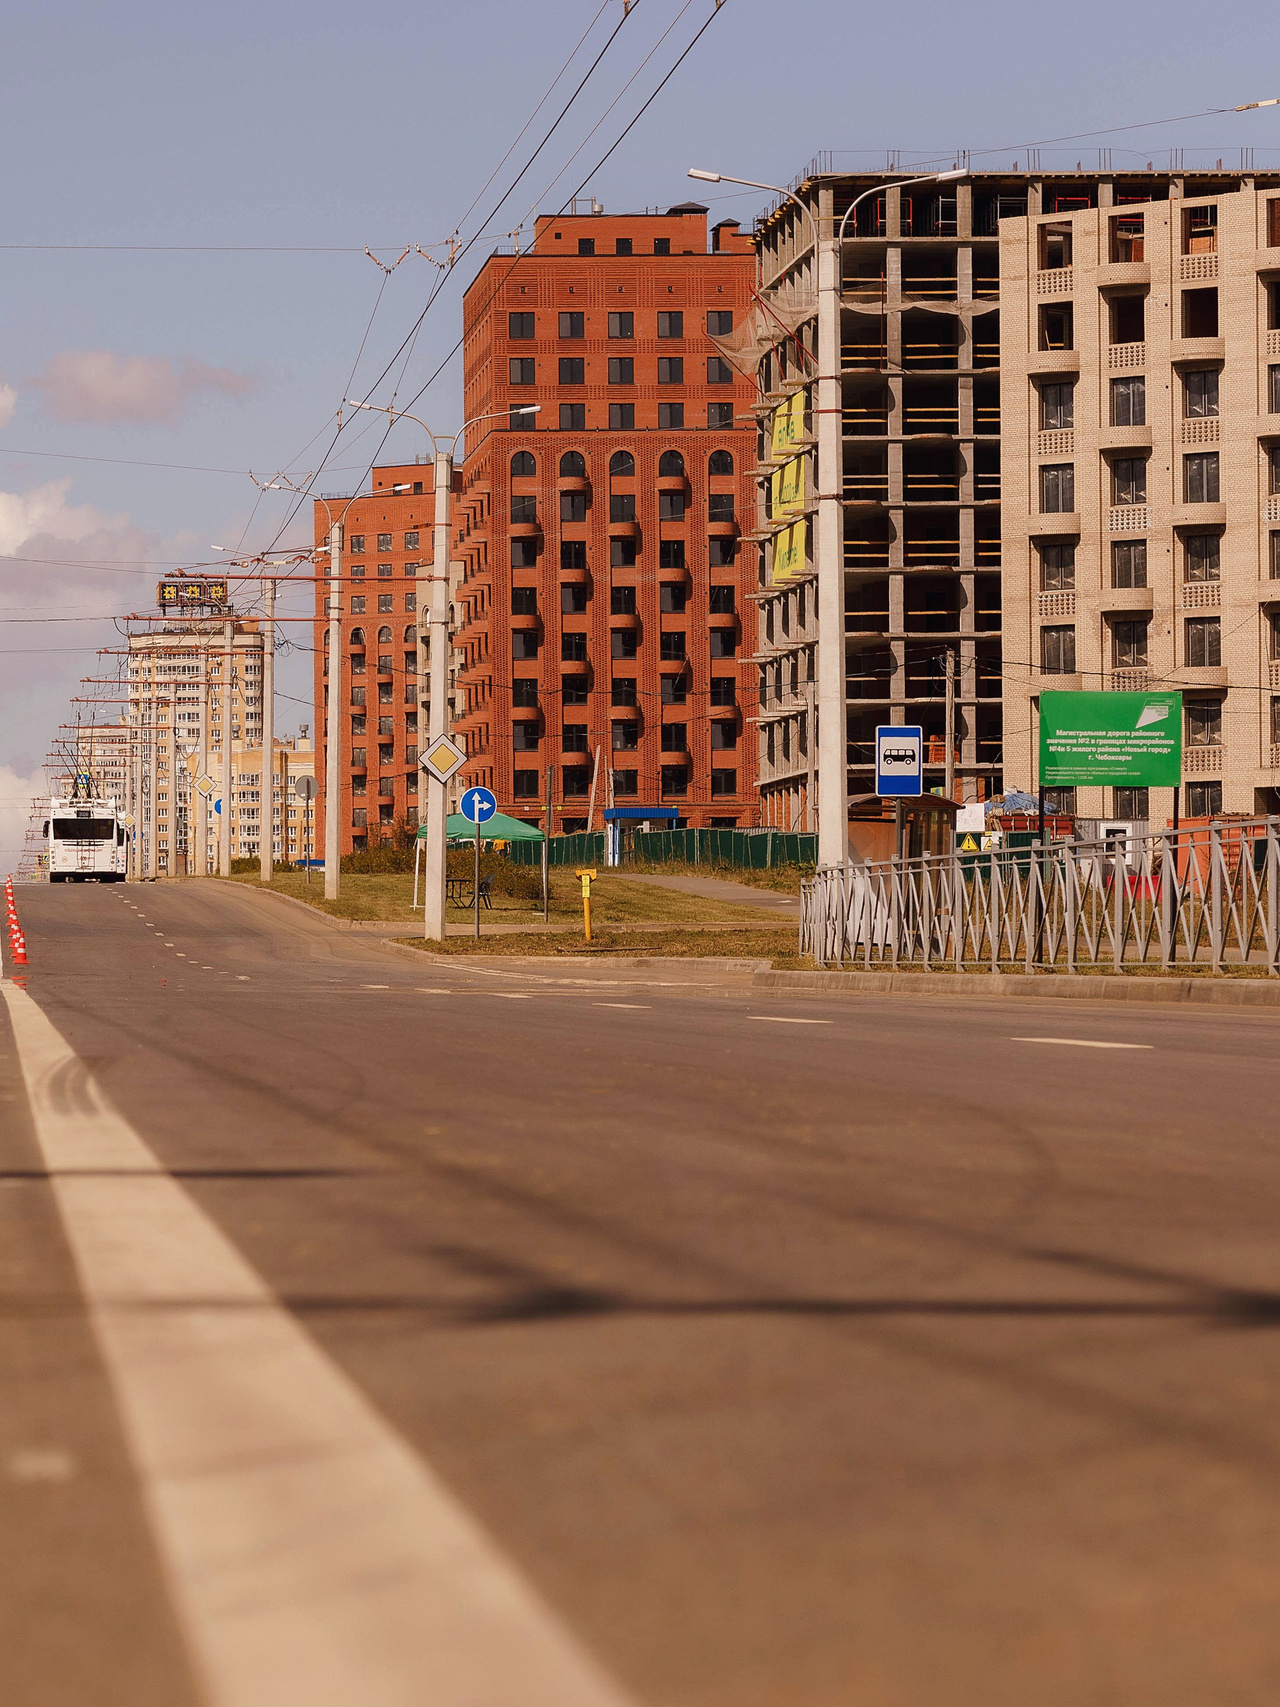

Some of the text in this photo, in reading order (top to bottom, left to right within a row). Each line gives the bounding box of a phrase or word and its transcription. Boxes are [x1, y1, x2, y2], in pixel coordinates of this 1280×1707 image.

[1131, 729, 1165, 738] районного
[1128, 738, 1175, 746] микрорайонов
[1095, 754, 1132, 762] Чебоксары
